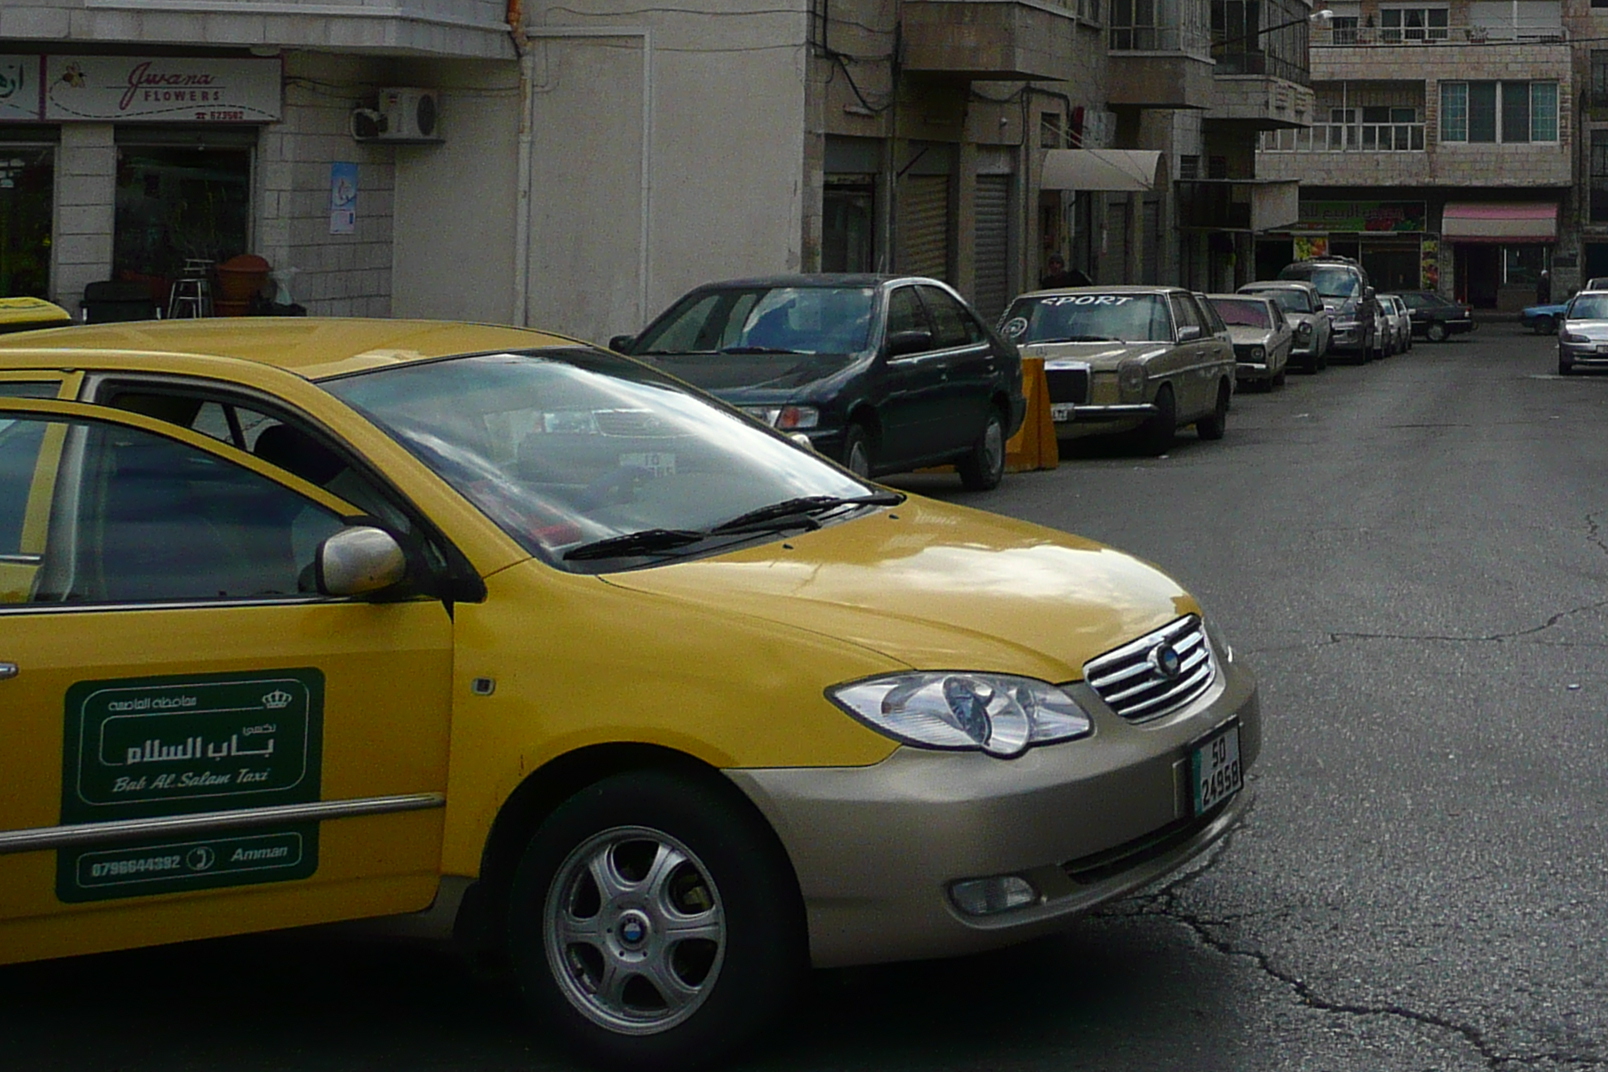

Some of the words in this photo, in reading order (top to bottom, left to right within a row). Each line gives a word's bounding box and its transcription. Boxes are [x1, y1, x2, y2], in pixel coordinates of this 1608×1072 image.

[144, 90, 220, 101] FLOWERS
[1041, 296, 1134, 306] SPORT
[127, 736, 202, 765] السلام
[207, 734, 275, 761] باب
[1212, 736, 1226, 769] 50
[112, 776, 147, 793] Bab
[236, 767, 272, 784] Taxi
[1202, 760, 1239, 806] 24958
[230, 845, 288, 862] Amman
